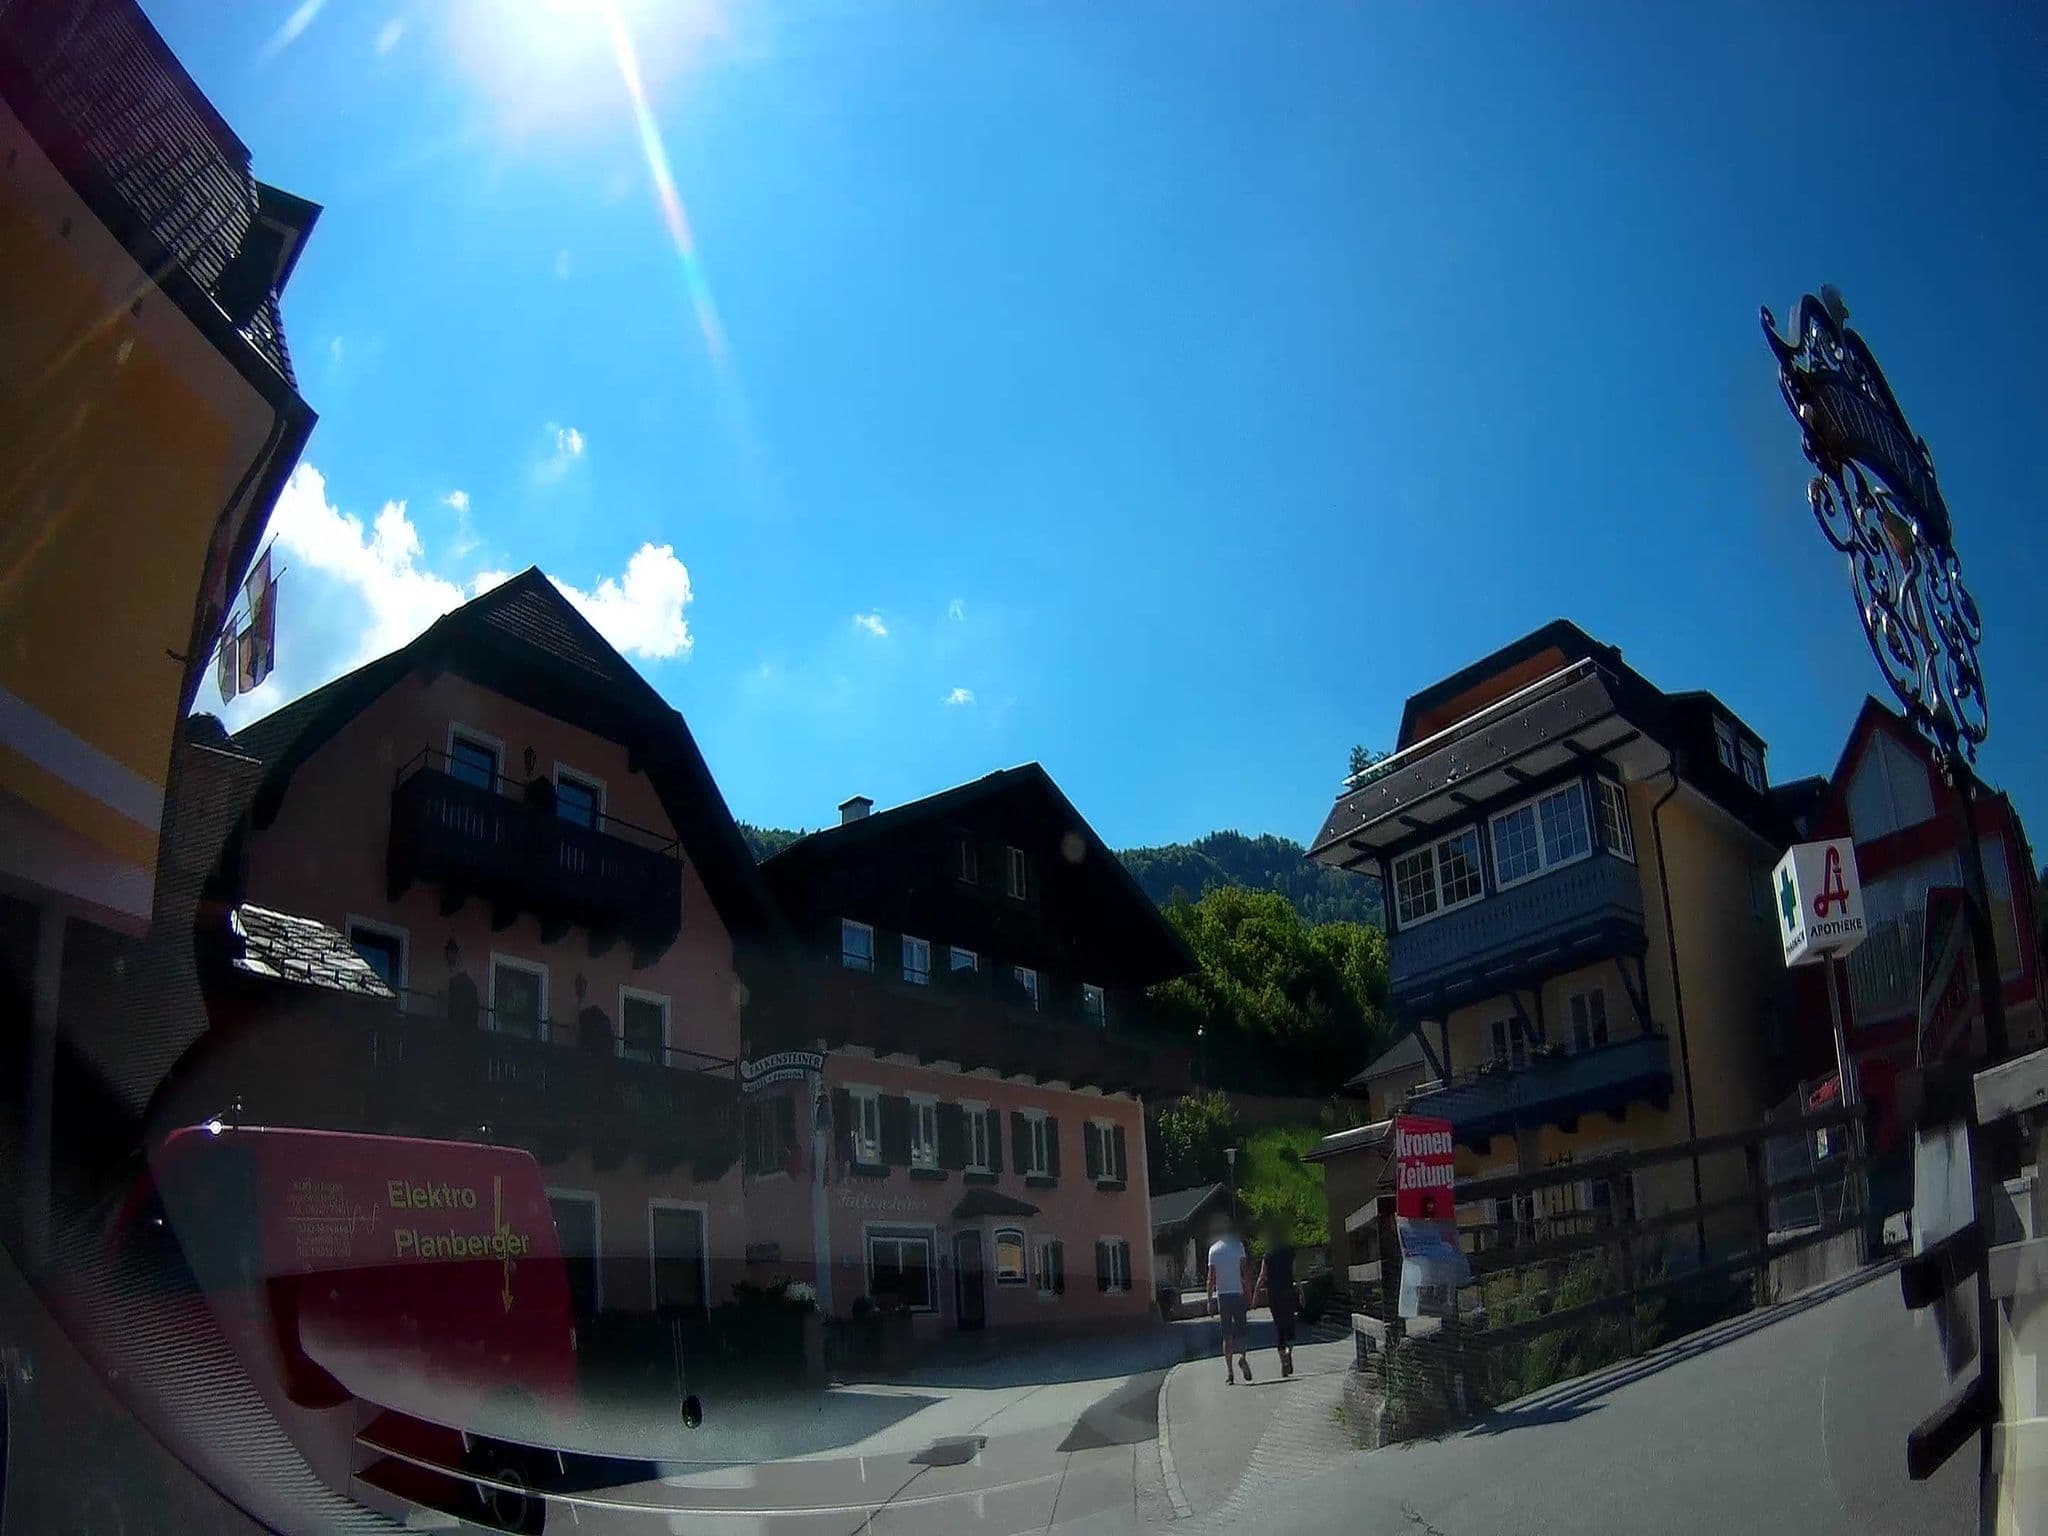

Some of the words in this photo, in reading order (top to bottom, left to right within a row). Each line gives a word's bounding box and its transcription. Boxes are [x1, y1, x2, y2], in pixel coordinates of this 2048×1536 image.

[1810, 918, 1862, 937] APOTHEKE
[1396, 1128, 1452, 1157] Kronen
[1398, 1161, 1455, 1189] Zeitung
[387, 1179, 477, 1208] Elektro
[395, 1227, 529, 1259] Planberger
